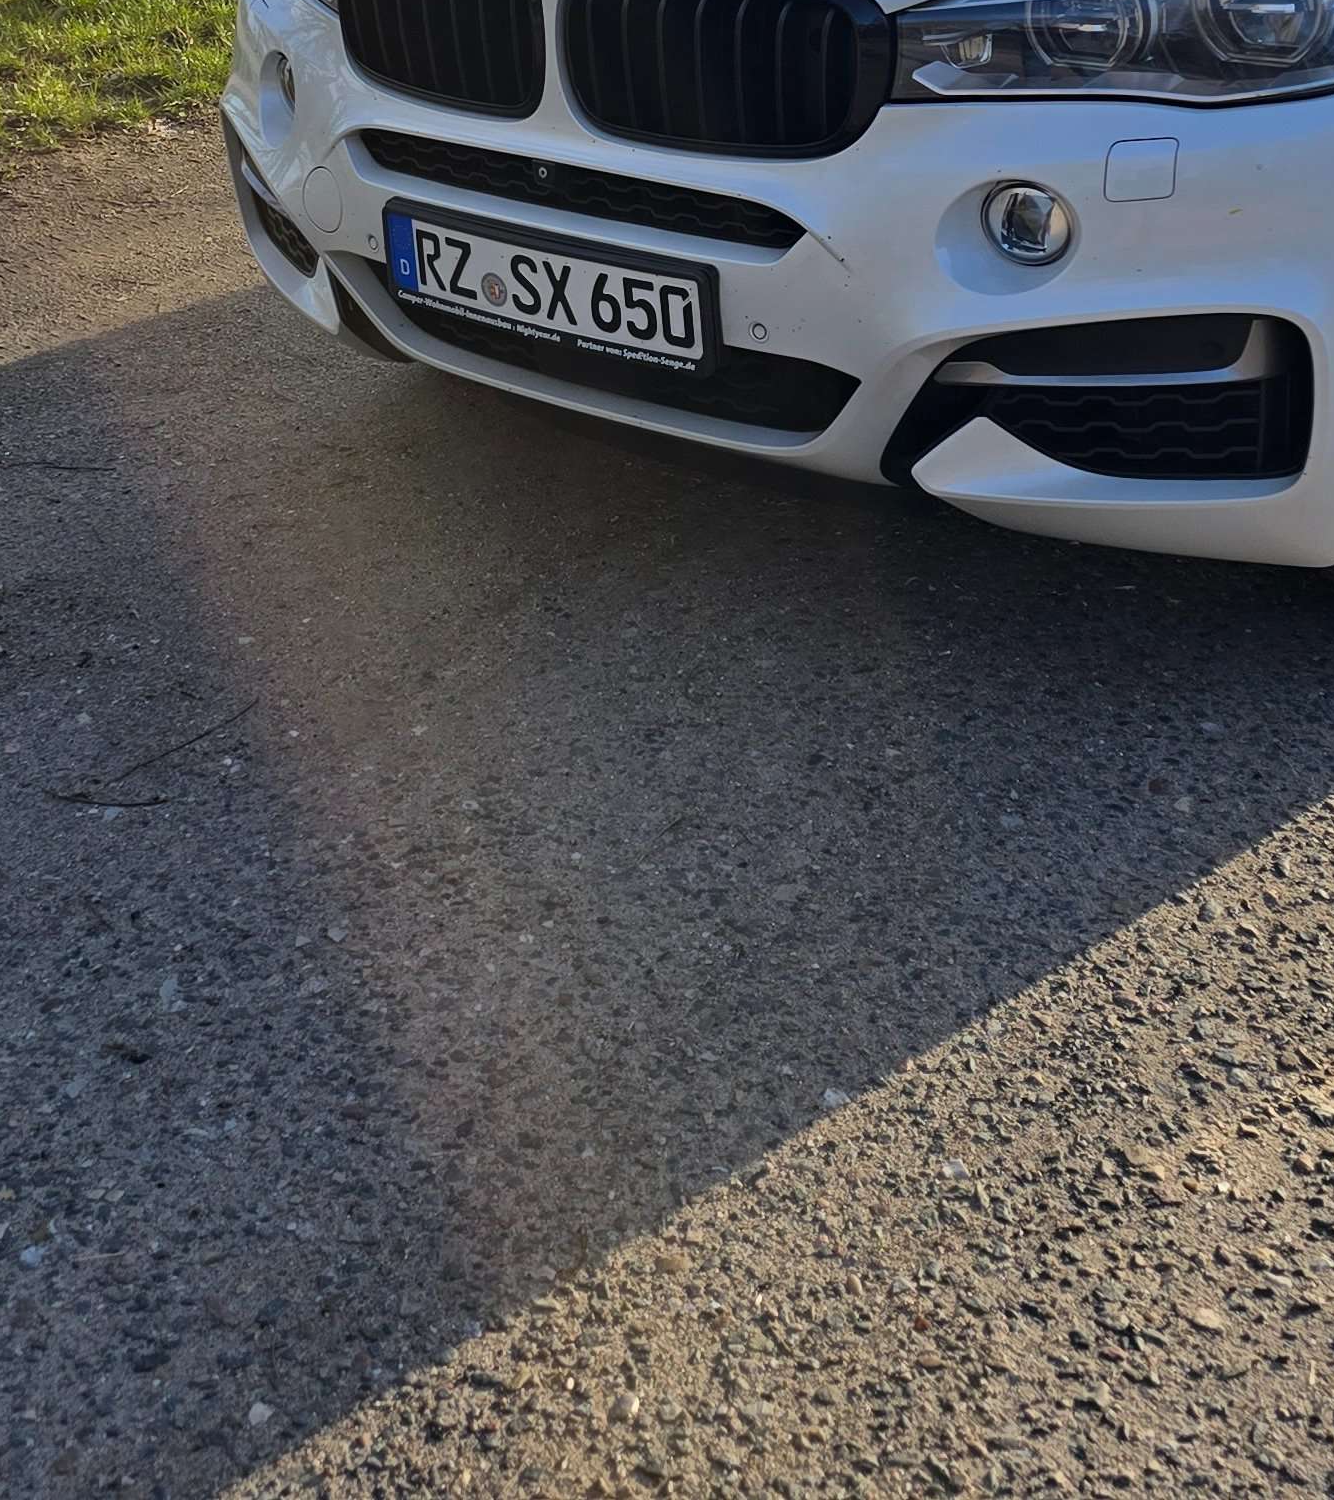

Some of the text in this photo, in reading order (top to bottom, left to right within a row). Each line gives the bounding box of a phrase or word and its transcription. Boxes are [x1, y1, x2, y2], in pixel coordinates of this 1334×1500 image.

[400, 258, 410, 276] D
[416, 228, 696, 349] RZ SX 650
